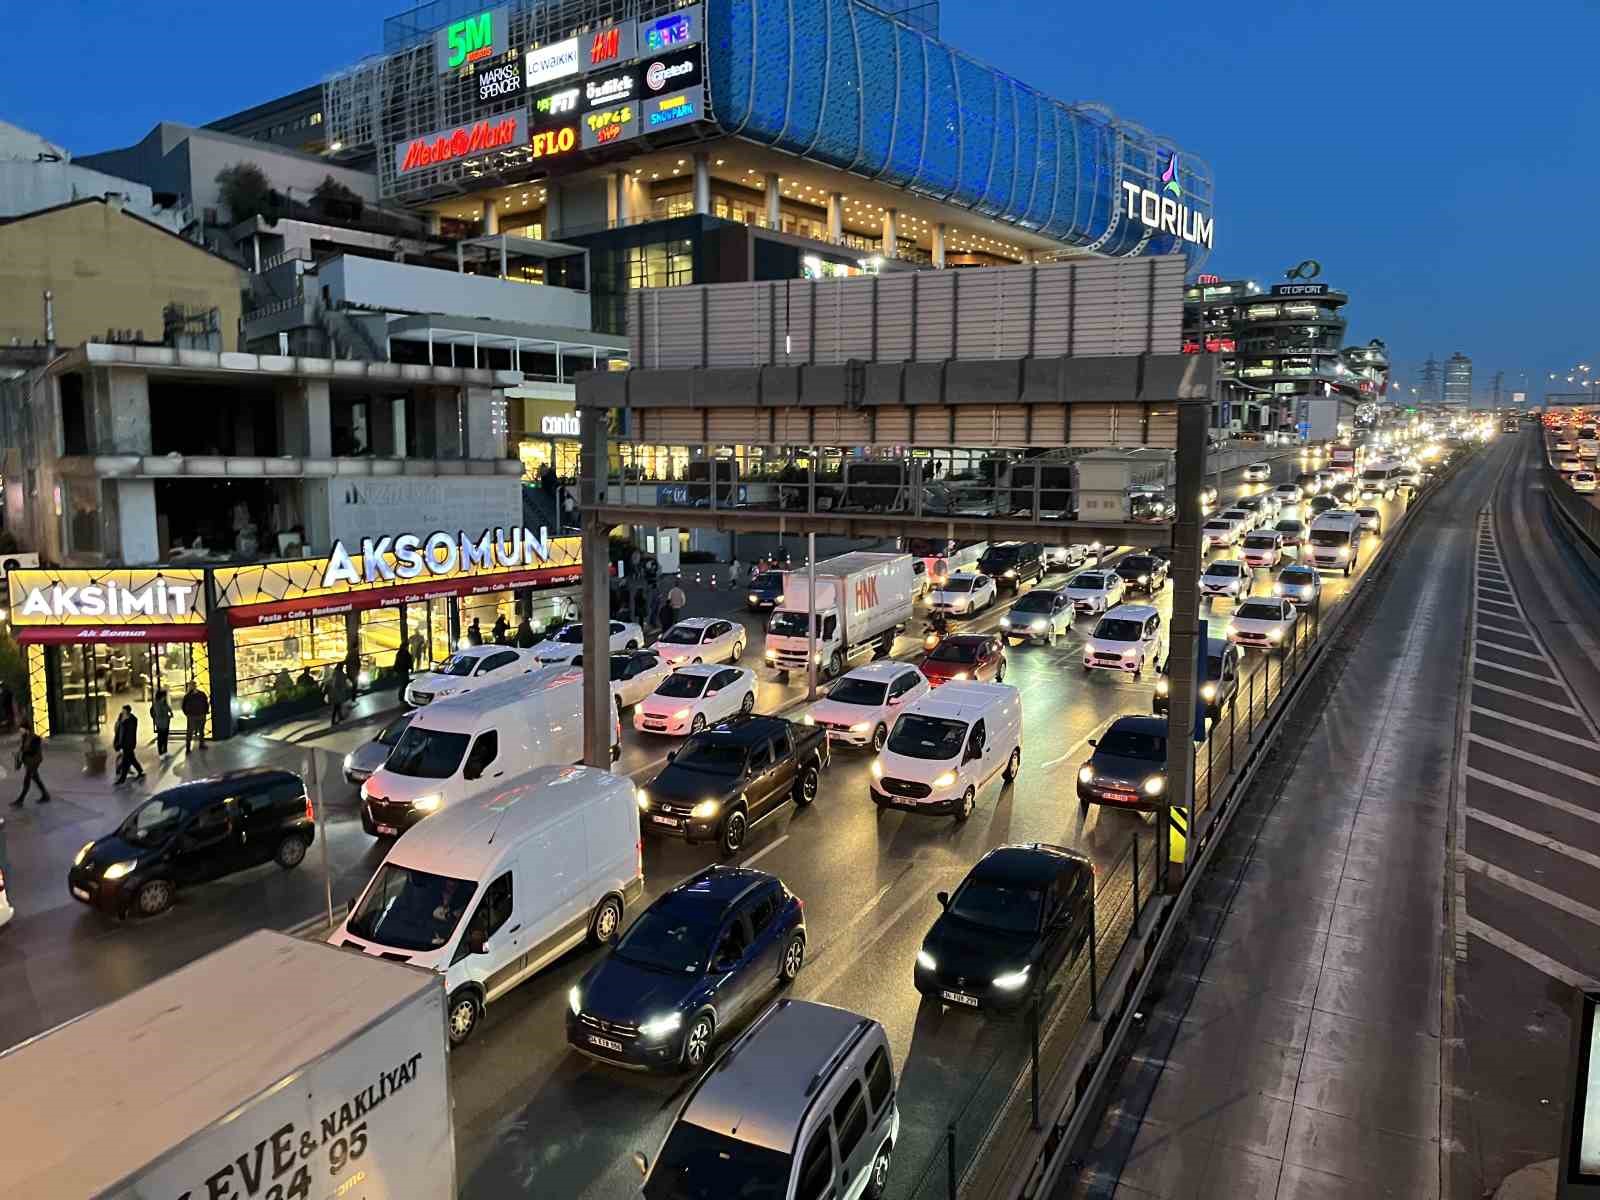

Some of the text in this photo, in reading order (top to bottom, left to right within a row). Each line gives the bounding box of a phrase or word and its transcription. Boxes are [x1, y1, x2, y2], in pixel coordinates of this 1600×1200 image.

[447, 11, 493, 67] 5M
[480, 76, 521, 100] SPENCER
[401, 117, 517, 172] Media Markt
[532, 128, 575, 158] FLO
[1122, 181, 1214, 249] TORIUM
[320, 525, 550, 588] AKSOMUN
[23, 580, 192, 616] AKSİMİT
[258, 603, 353, 623] Pasta Cafe Restaurant
[424, 589, 458, 600] Restaurant
[100, 629, 146, 637] Somun
[320, 1052, 422, 1146] NAKLİYAT
[328, 1122, 368, 1175] 95
